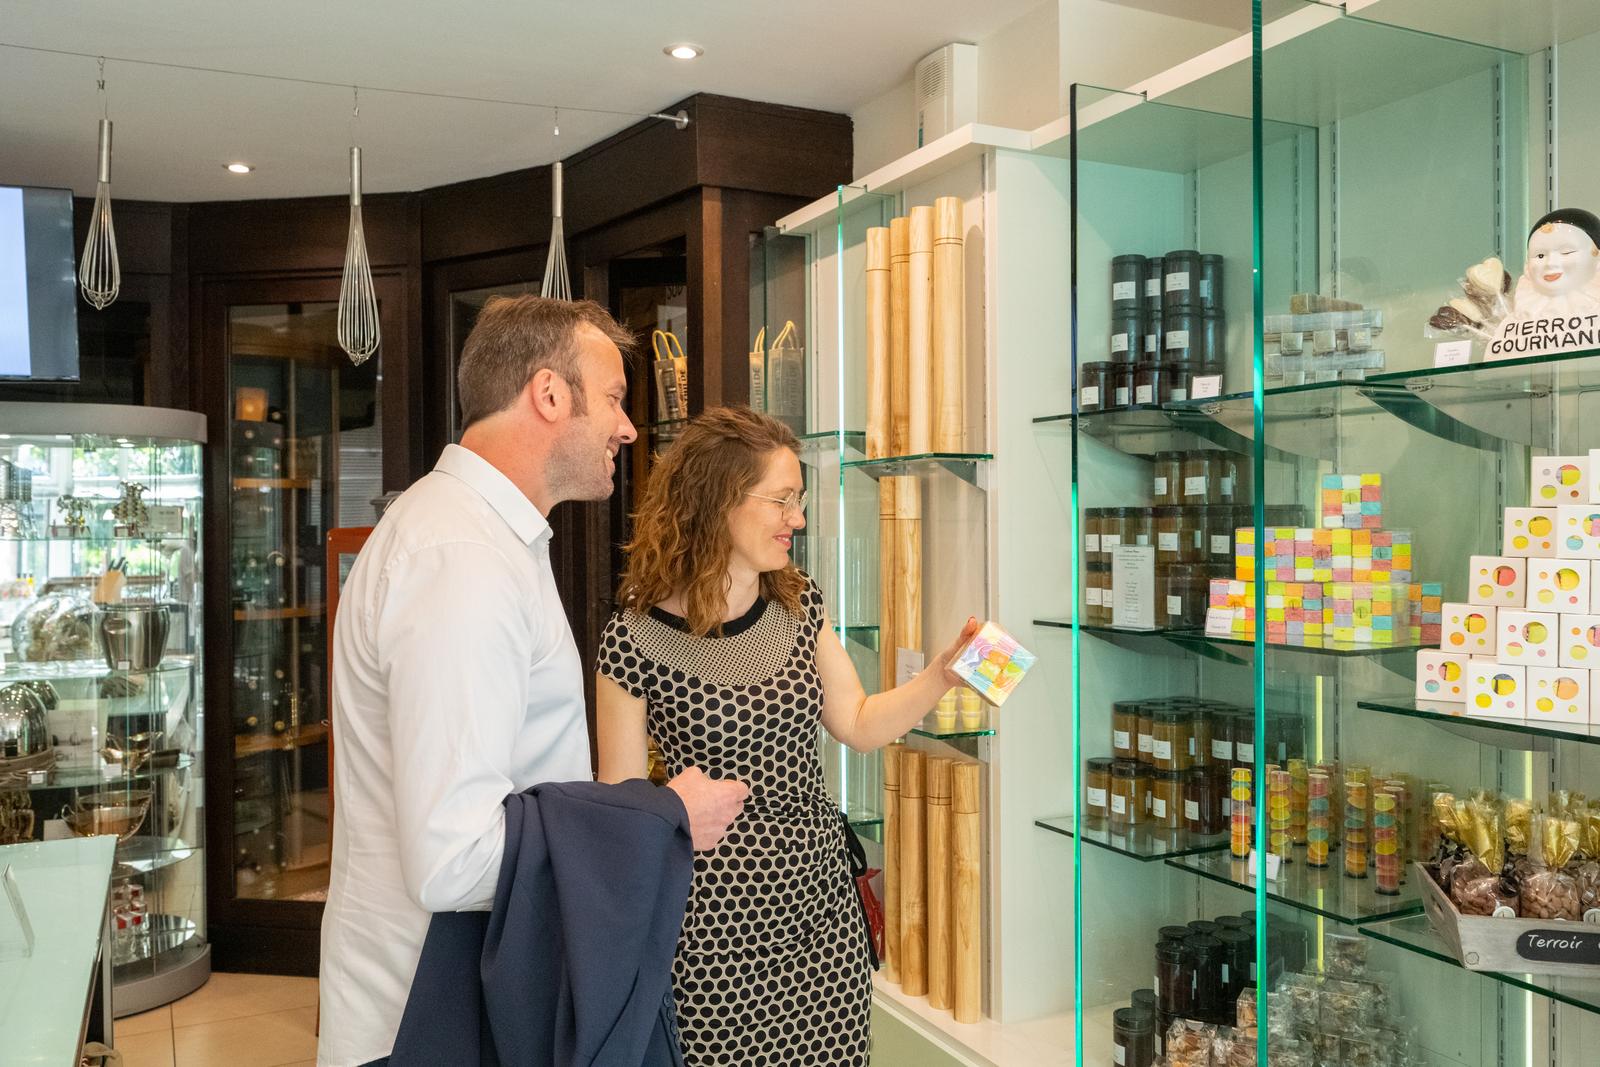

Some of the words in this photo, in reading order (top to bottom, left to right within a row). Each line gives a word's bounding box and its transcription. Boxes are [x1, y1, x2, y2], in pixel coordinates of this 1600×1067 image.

[1504, 315, 1598, 338] PIERROT
[1491, 329, 1600, 354] GOURMAN
[1527, 934, 1583, 949] Terroir
